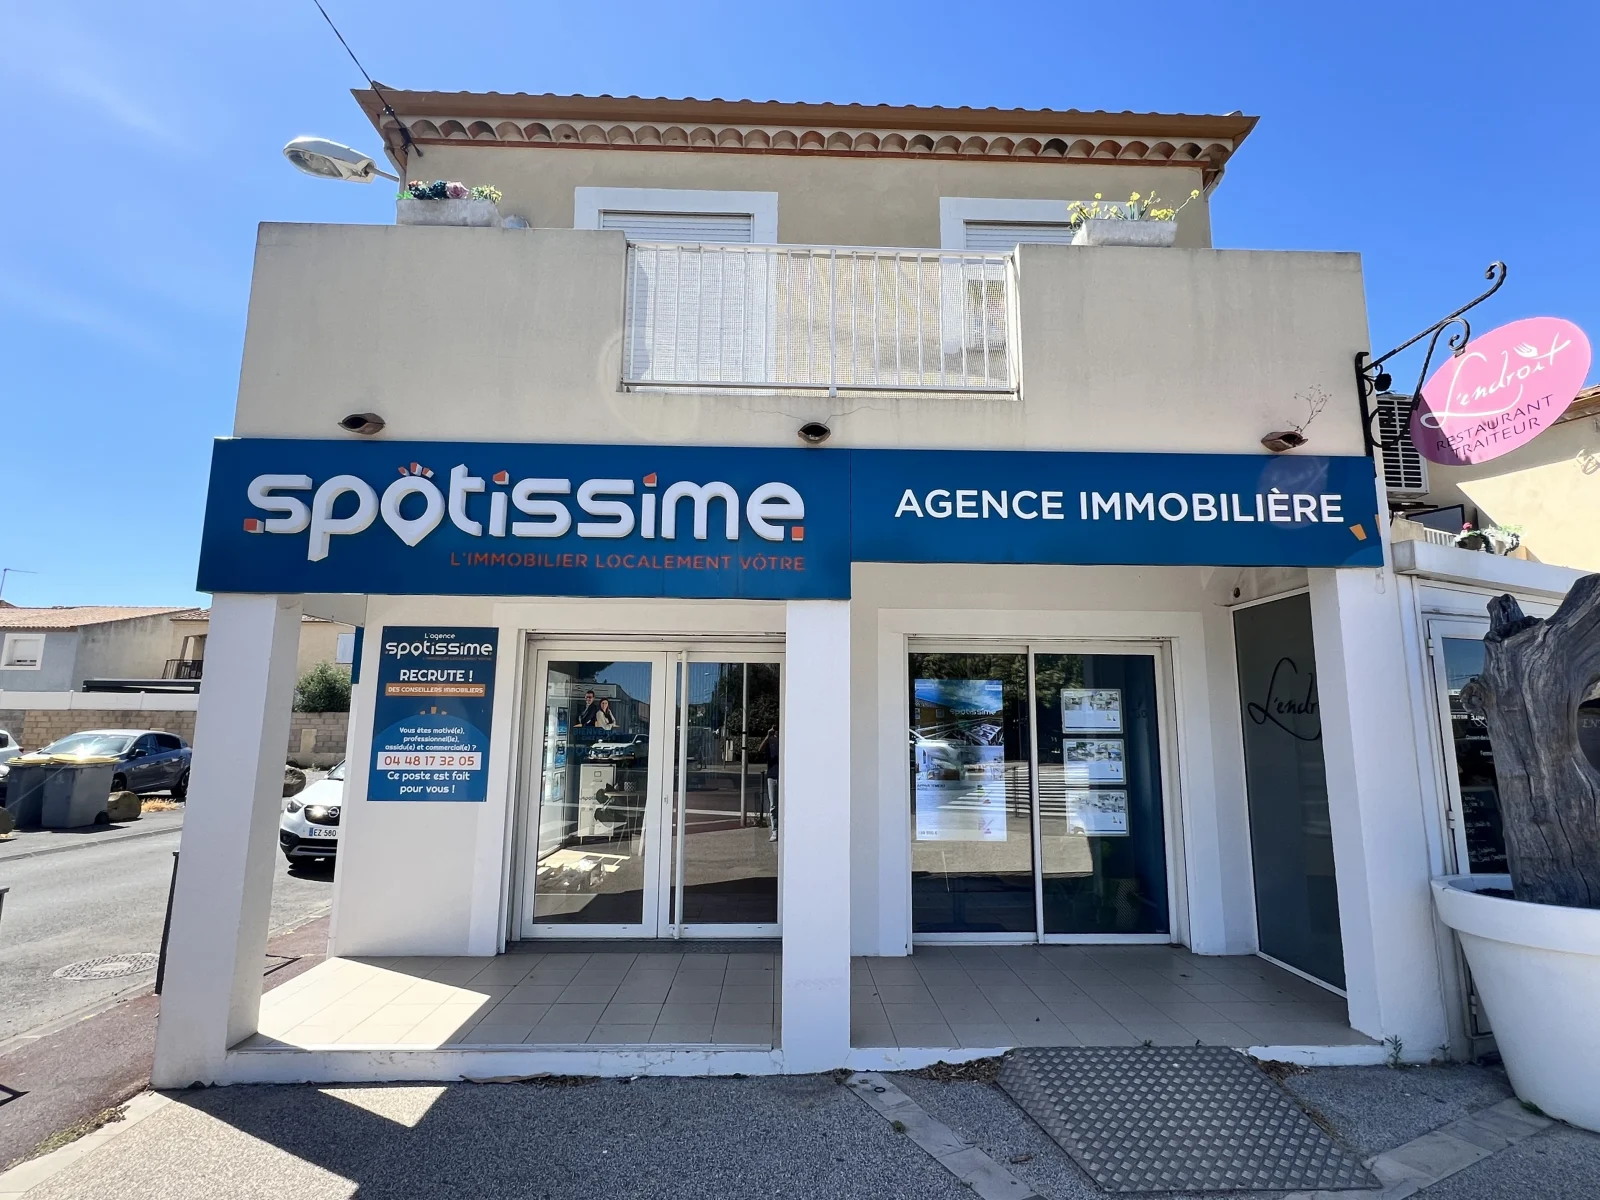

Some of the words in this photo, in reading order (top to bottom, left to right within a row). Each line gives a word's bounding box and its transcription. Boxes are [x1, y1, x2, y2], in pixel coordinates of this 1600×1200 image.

[1436, 394, 1553, 451] RESTAURANT
[1451, 417, 1541, 458] TRAITEUR
[894, 488, 1065, 520] AGENCE
[1079, 487, 1345, 523] IMMOBILIÈRE
[450, 552, 588, 568] L'IMMOBILIER
[596, 554, 731, 570] LOCALEMENT
[740, 552, 805, 571] VÔTRE
[424, 632, 456, 641] L'agence
[400, 669, 465, 682] RECRUTE
[1247, 657, 1320, 741] L'endr
[425, 744, 470, 752] commercial(e)
[384, 755, 400, 766] 04
[405, 755, 420, 766] 48
[425, 756, 435, 766] 17
[440, 756, 454, 766] 32
[458, 756, 475, 766] 05
[387, 771, 400, 780] Ce
[402, 771, 430, 782] poste
[433, 771, 449, 780] est
[452, 771, 470, 781] fait
[400, 785, 423, 795] pour
[426, 785, 449, 793] vous
[313, 828, 322, 836] EZ
[324, 829, 337, 837] 580
